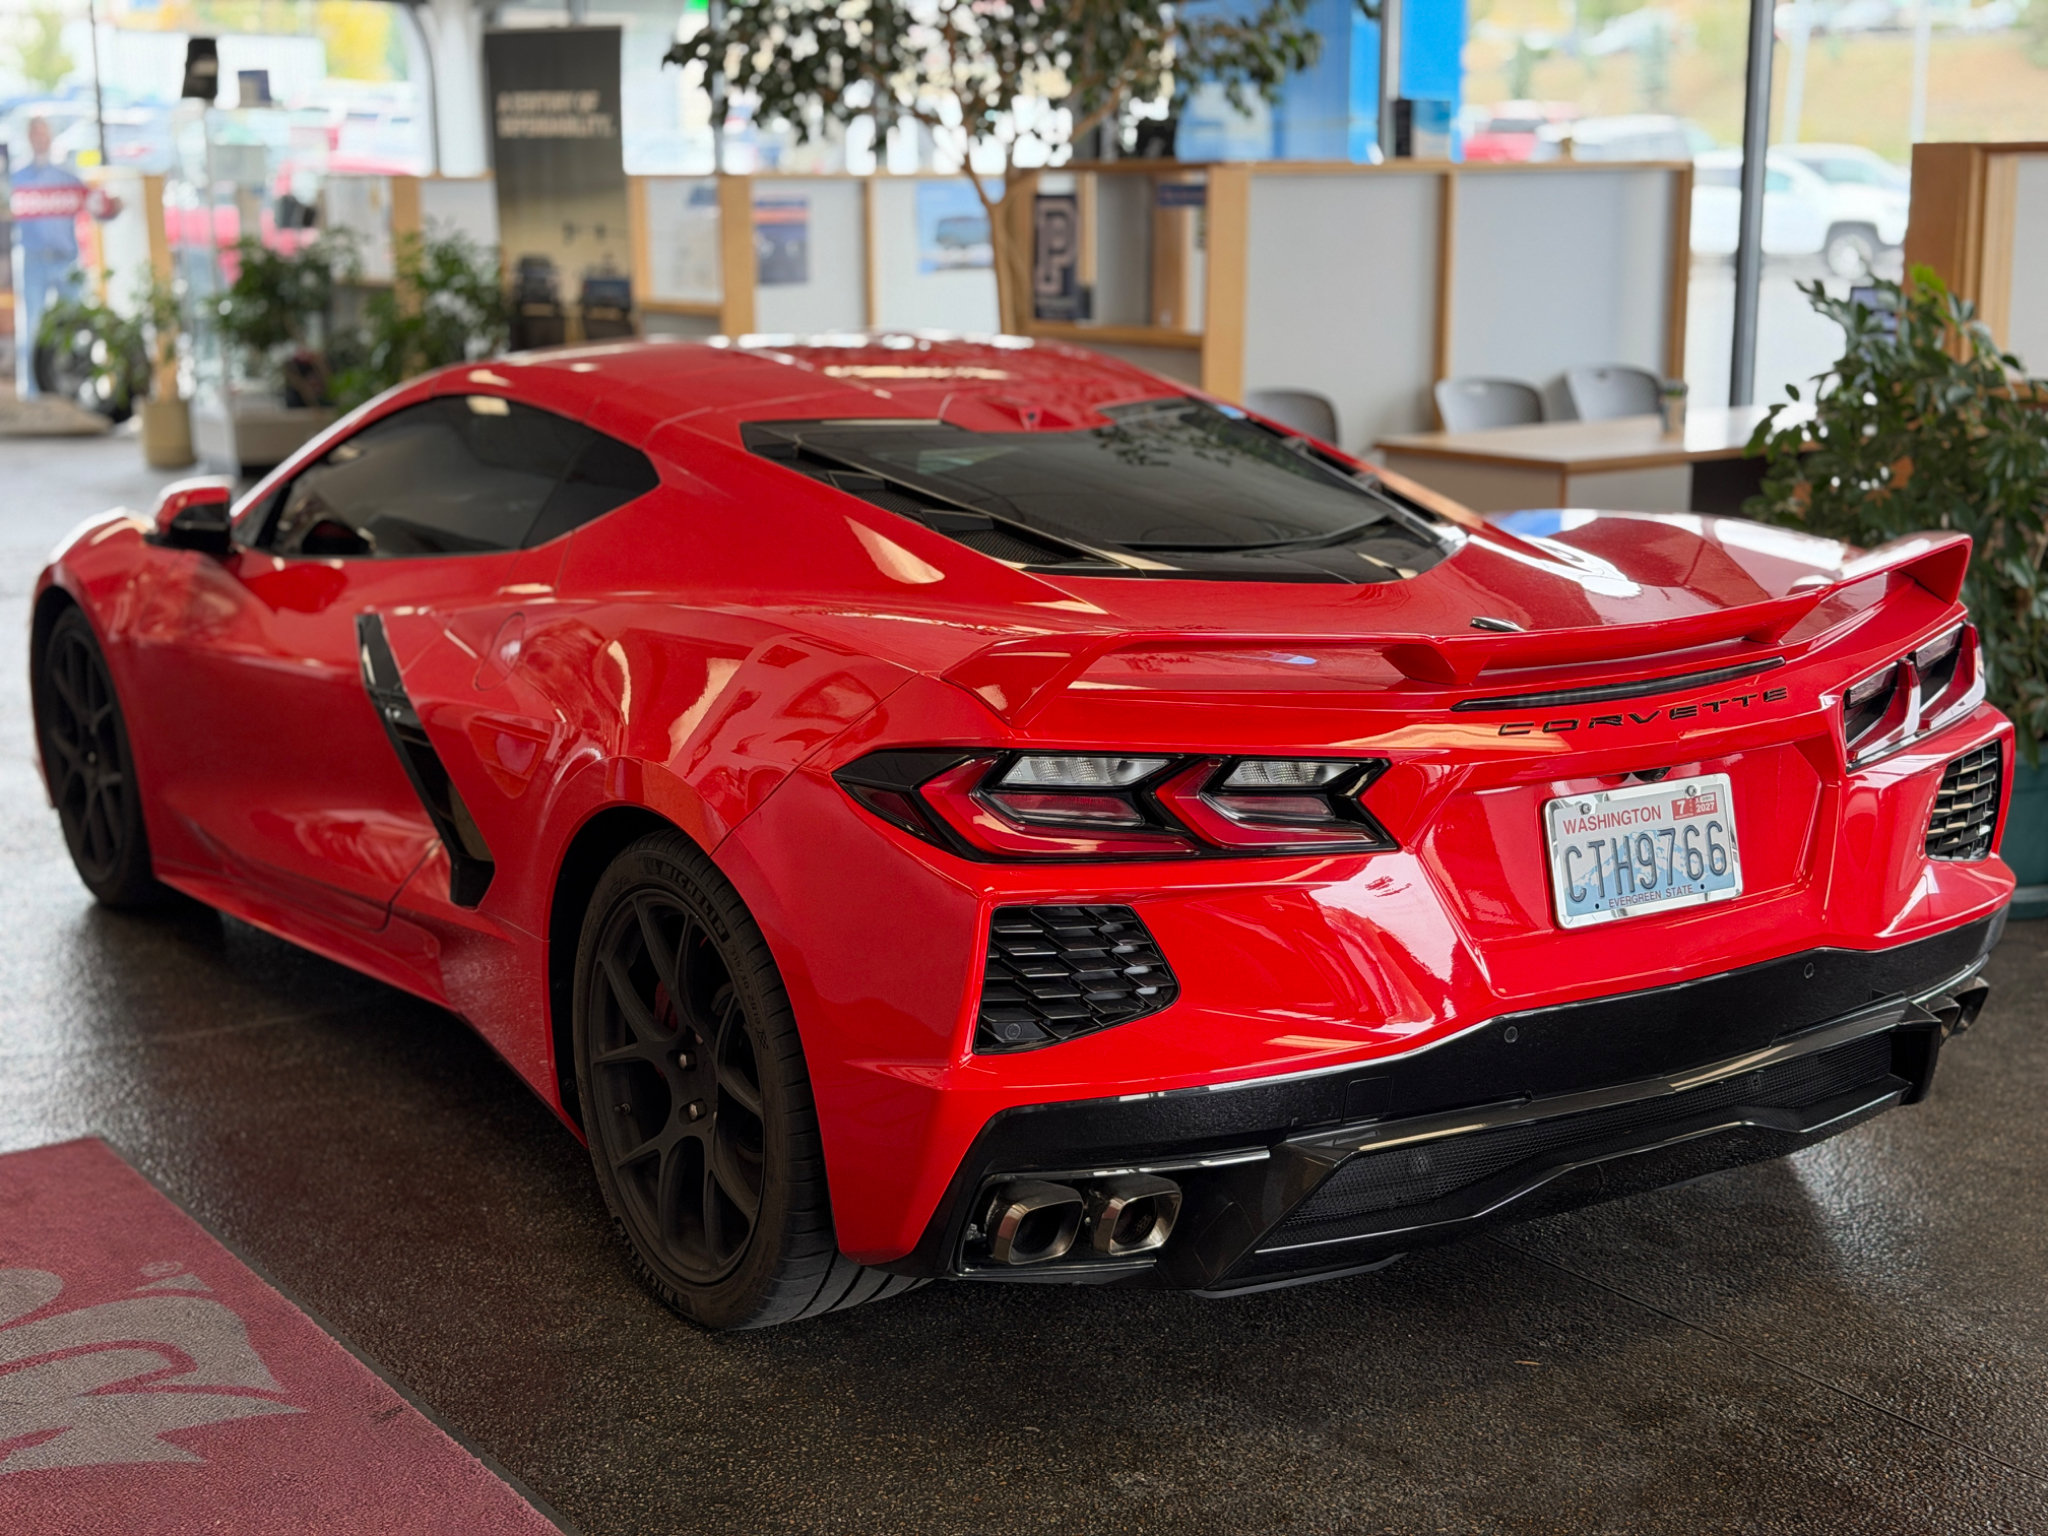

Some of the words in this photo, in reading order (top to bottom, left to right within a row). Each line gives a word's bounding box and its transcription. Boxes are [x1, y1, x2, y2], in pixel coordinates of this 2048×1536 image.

[1498, 686, 1789, 736] CORVETTE
[1563, 805, 1662, 834] WASHINGTON
[1676, 800, 1686, 815] 7
[1696, 802, 1715, 813] 2027
[1565, 820, 1727, 903] CTH9766
[660, 862, 726, 936] MICHELIN
[1608, 890, 1662, 908] EVERGREEN
[1666, 885, 1694, 897] STATE
